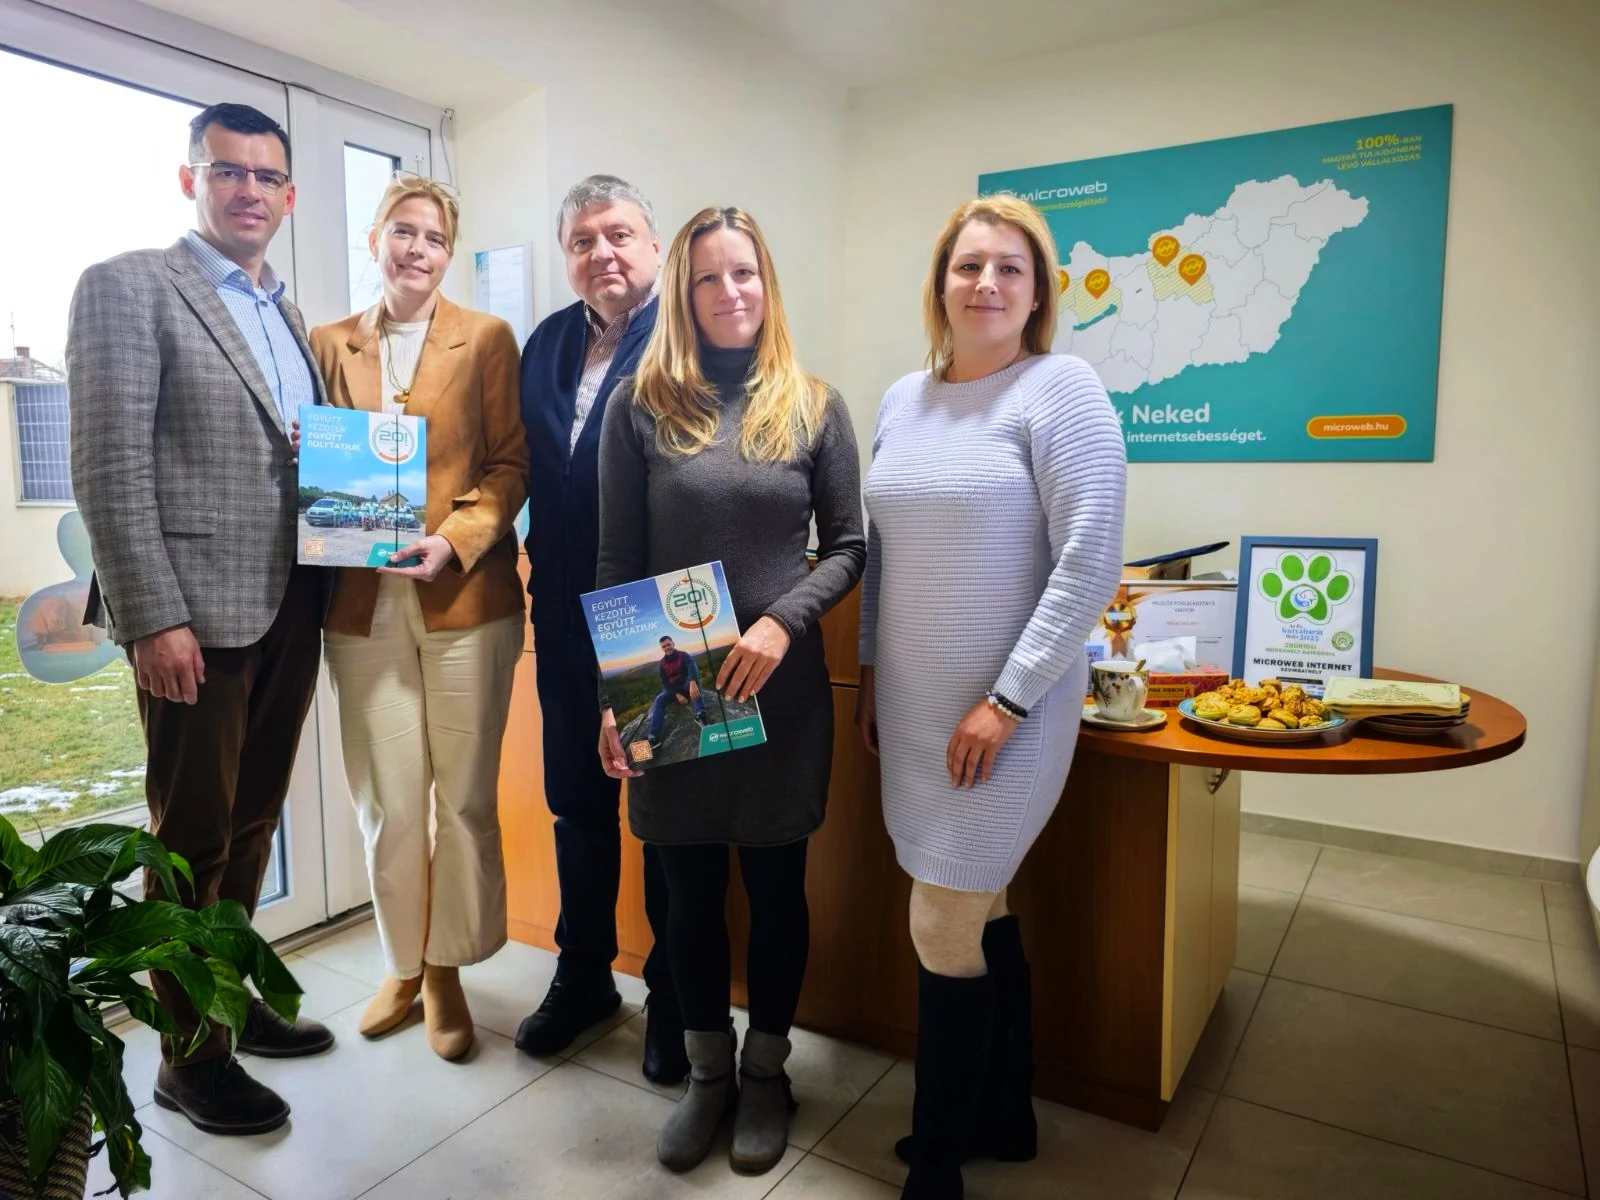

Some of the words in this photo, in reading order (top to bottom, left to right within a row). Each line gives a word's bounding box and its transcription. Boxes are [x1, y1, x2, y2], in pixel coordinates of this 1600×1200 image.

[1132, 402, 1210, 424] Neked
[1323, 422, 1389, 432] microweb.hu
[1127, 428, 1266, 444] internetsebességet.
[600, 622, 658, 642] FOLYTATJUK
[1253, 658, 1304, 668] MICROWEB
[1307, 661, 1352, 671] INTERNET
[1280, 667, 1322, 675] SZOMBATHELY
